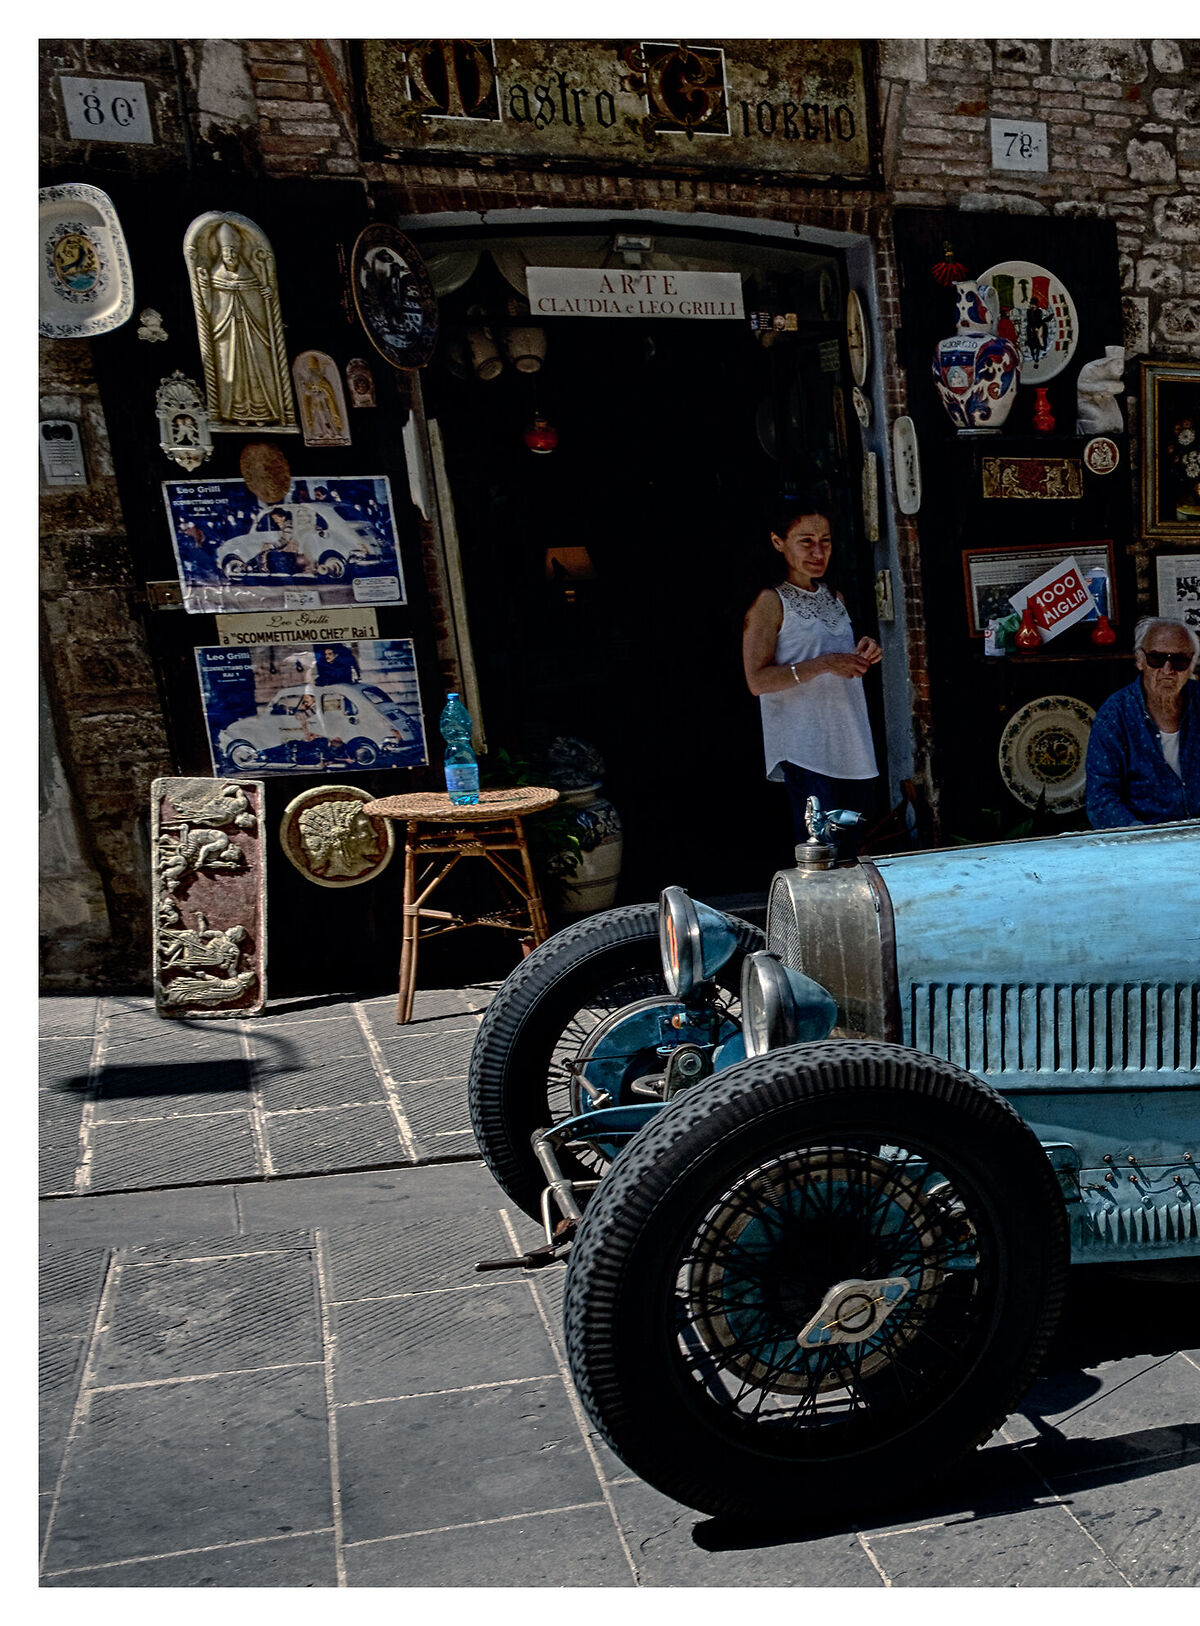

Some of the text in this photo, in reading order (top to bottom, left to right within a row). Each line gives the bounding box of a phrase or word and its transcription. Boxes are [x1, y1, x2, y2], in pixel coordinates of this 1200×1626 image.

[599, 274, 677, 295] ARTE
[538, 298, 736, 316] CLAUDIA e LEO GRILLI
[1036, 576, 1075, 607] 1000
[1043, 589, 1087, 625] MIGLIA
[223, 636, 230, 645] a
[351, 627, 367, 638] Rai
[369, 626, 376, 637] 1
